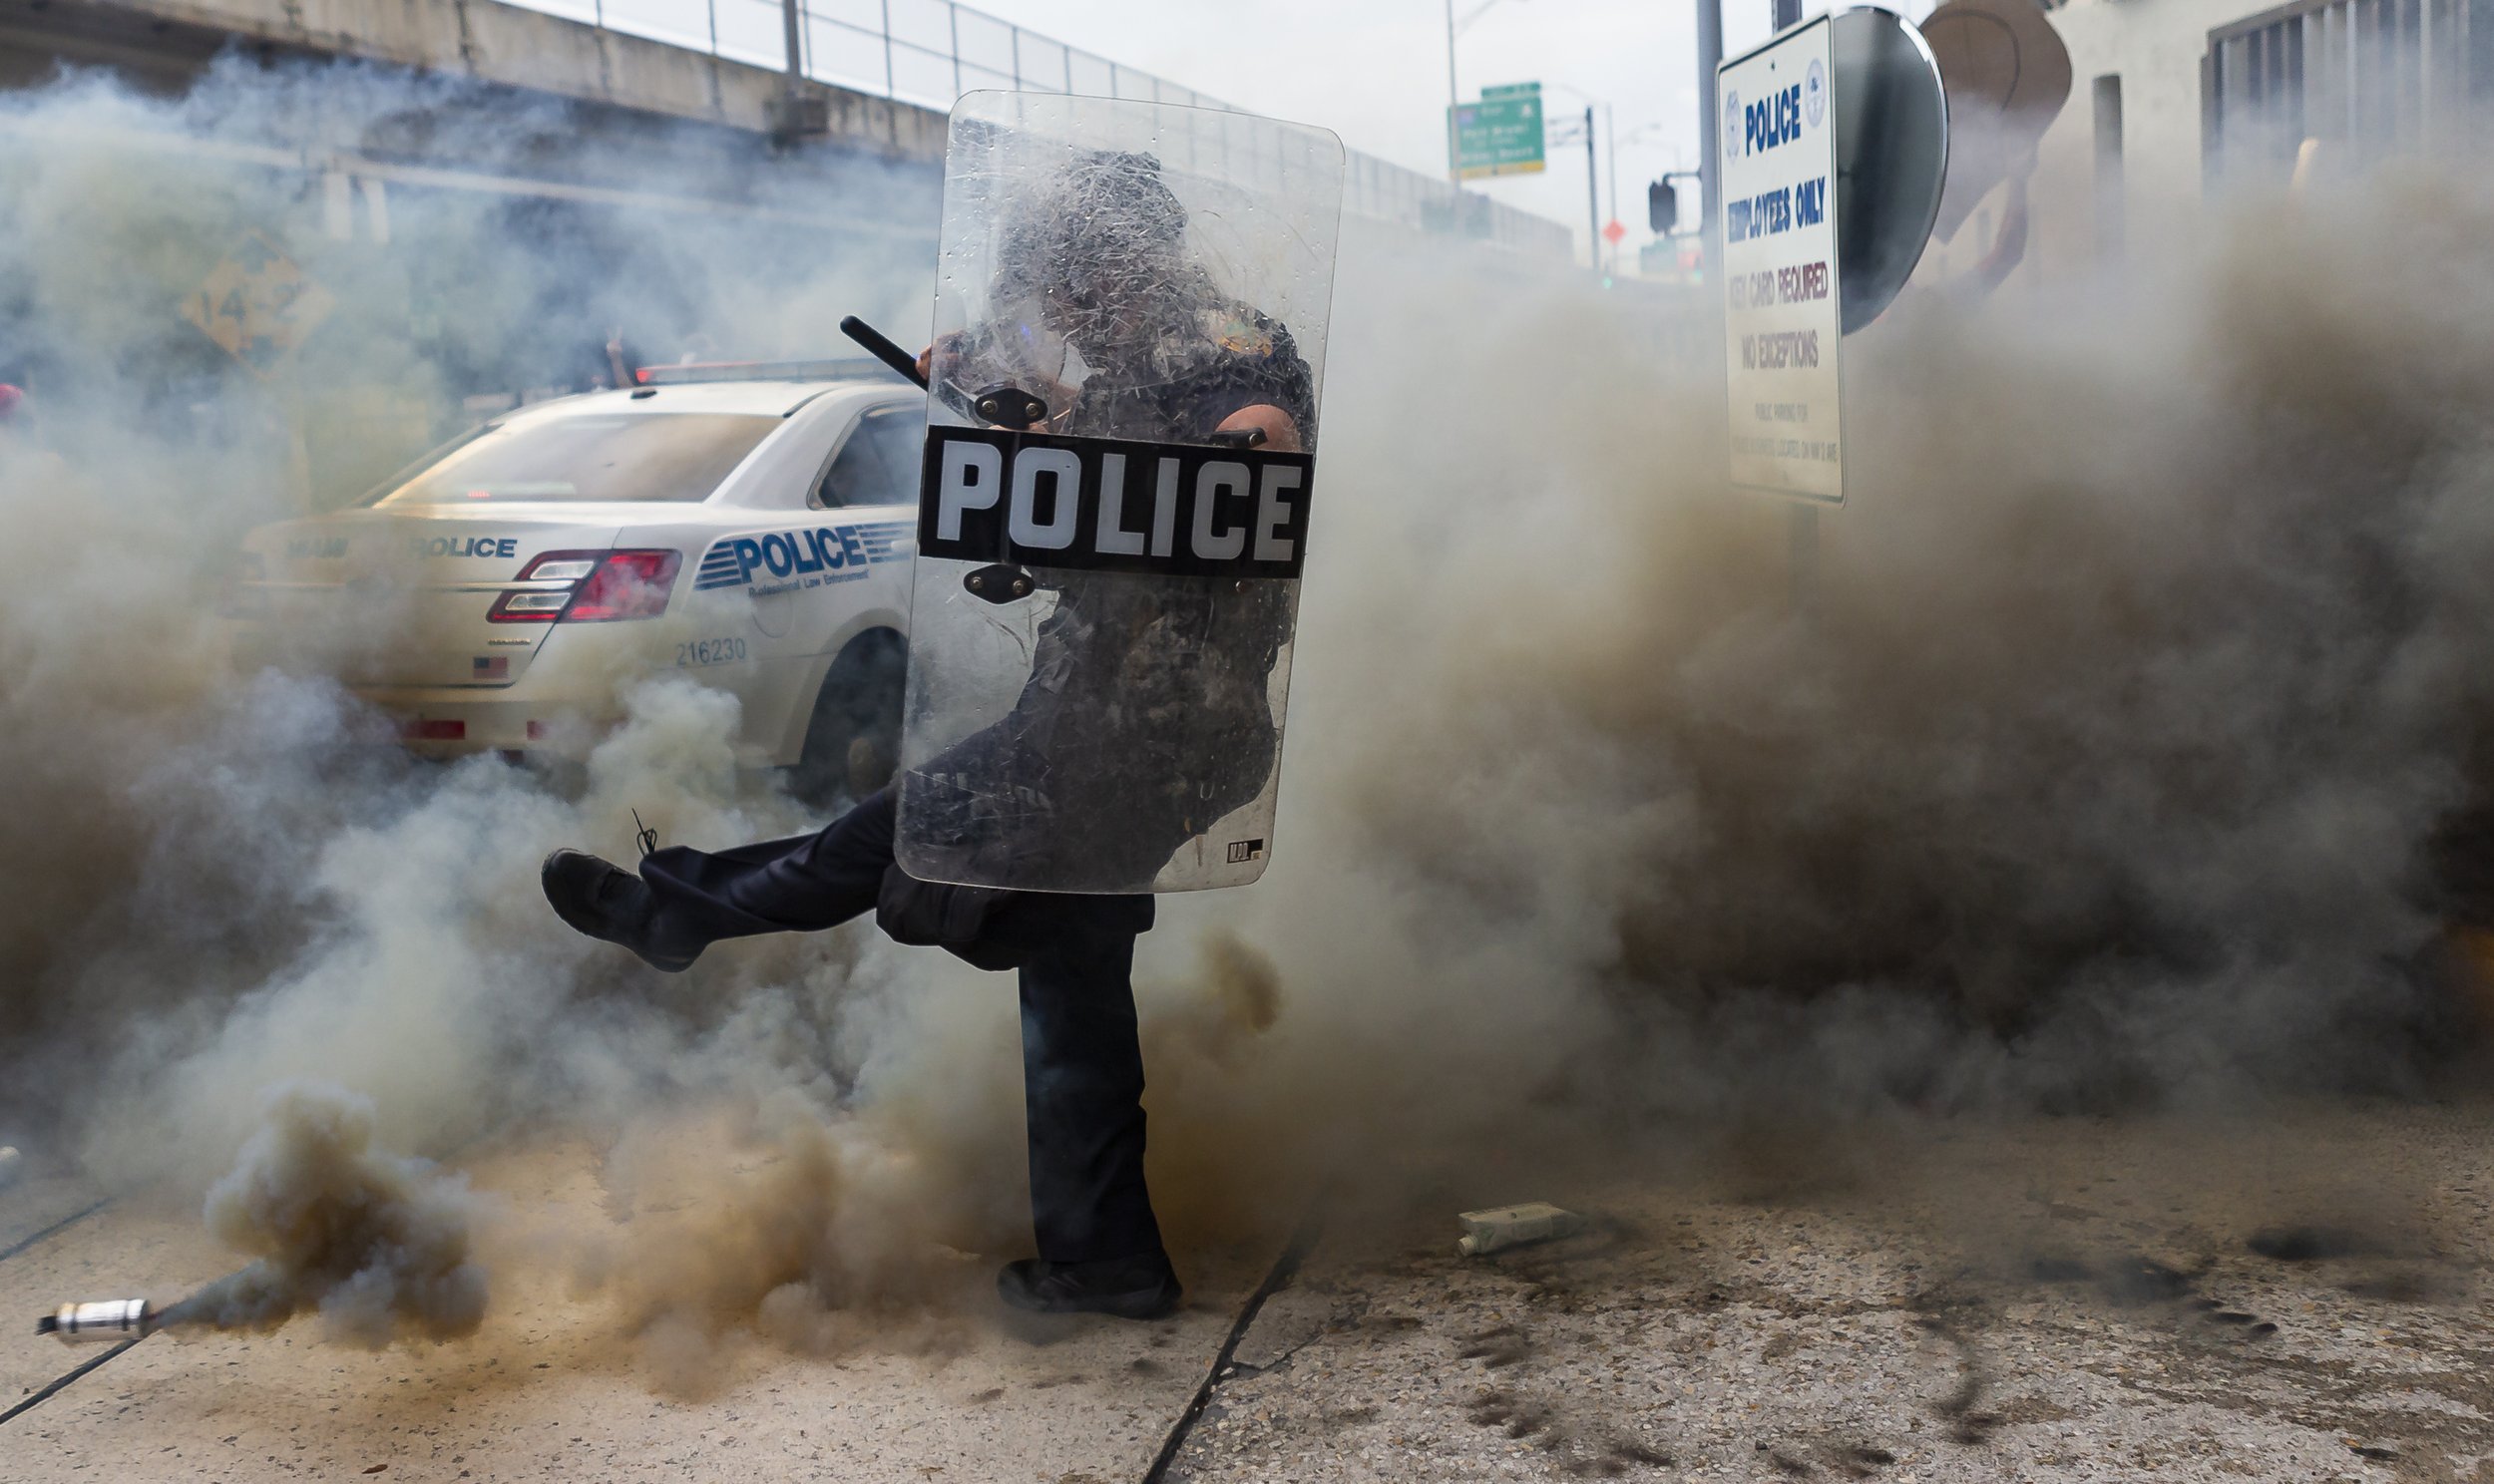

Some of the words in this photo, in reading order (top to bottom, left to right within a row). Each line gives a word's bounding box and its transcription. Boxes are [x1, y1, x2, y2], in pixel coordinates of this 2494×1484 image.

[1746, 83, 1801, 158] POLICE
[1728, 186, 1791, 243] EMPLOYEES
[1796, 177, 1825, 228] ONLY
[1750, 270, 1775, 308] CARD
[1778, 261, 1829, 303] REQUIRED
[1742, 334, 1756, 370] NO
[1759, 328, 1818, 369] EXCEPTIONS
[936, 439, 1303, 561] POLICE
[409, 537, 519, 558] POLICE
[732, 525, 868, 584] POLICE
[804, 577, 821, 588] Law
[676, 637, 746, 665] 216230
